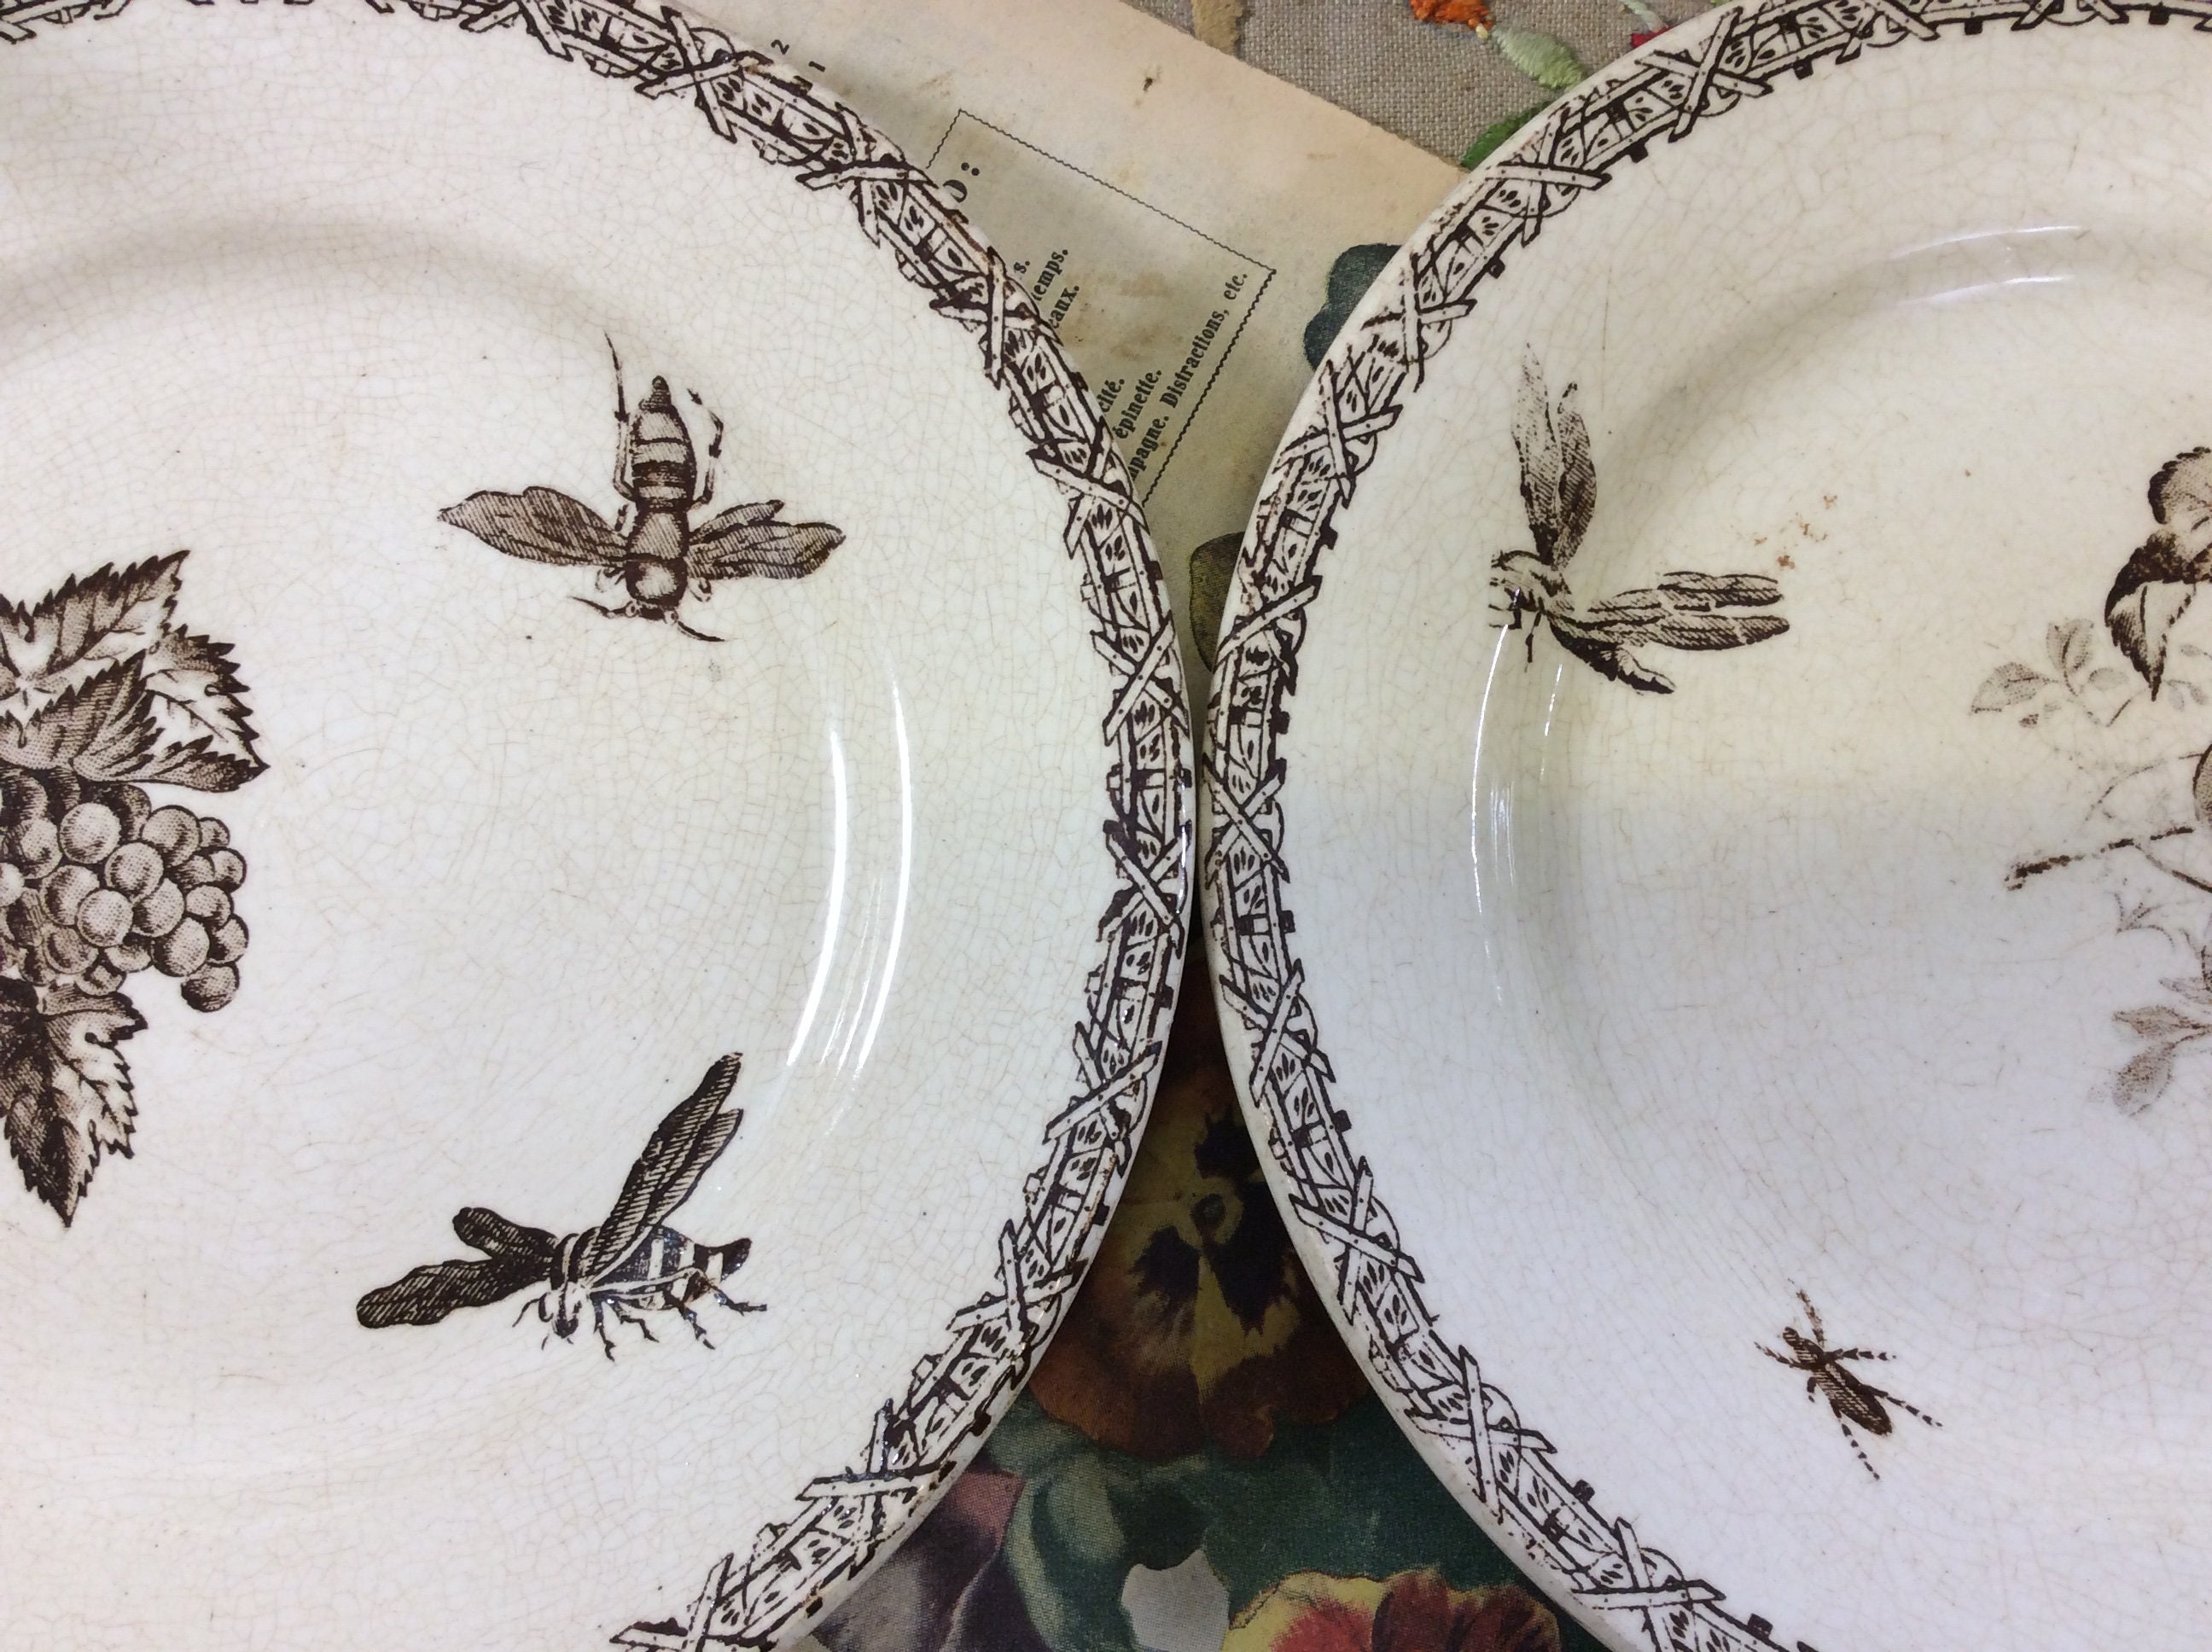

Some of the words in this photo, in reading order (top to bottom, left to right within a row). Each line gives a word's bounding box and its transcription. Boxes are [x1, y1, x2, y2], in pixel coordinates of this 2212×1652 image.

[771, 39, 789, 55] 2
[1159, 309, 1231, 409] Distractions,
[1223, 273, 1249, 300] etc.
[1112, 369, 1162, 439] épinette.
